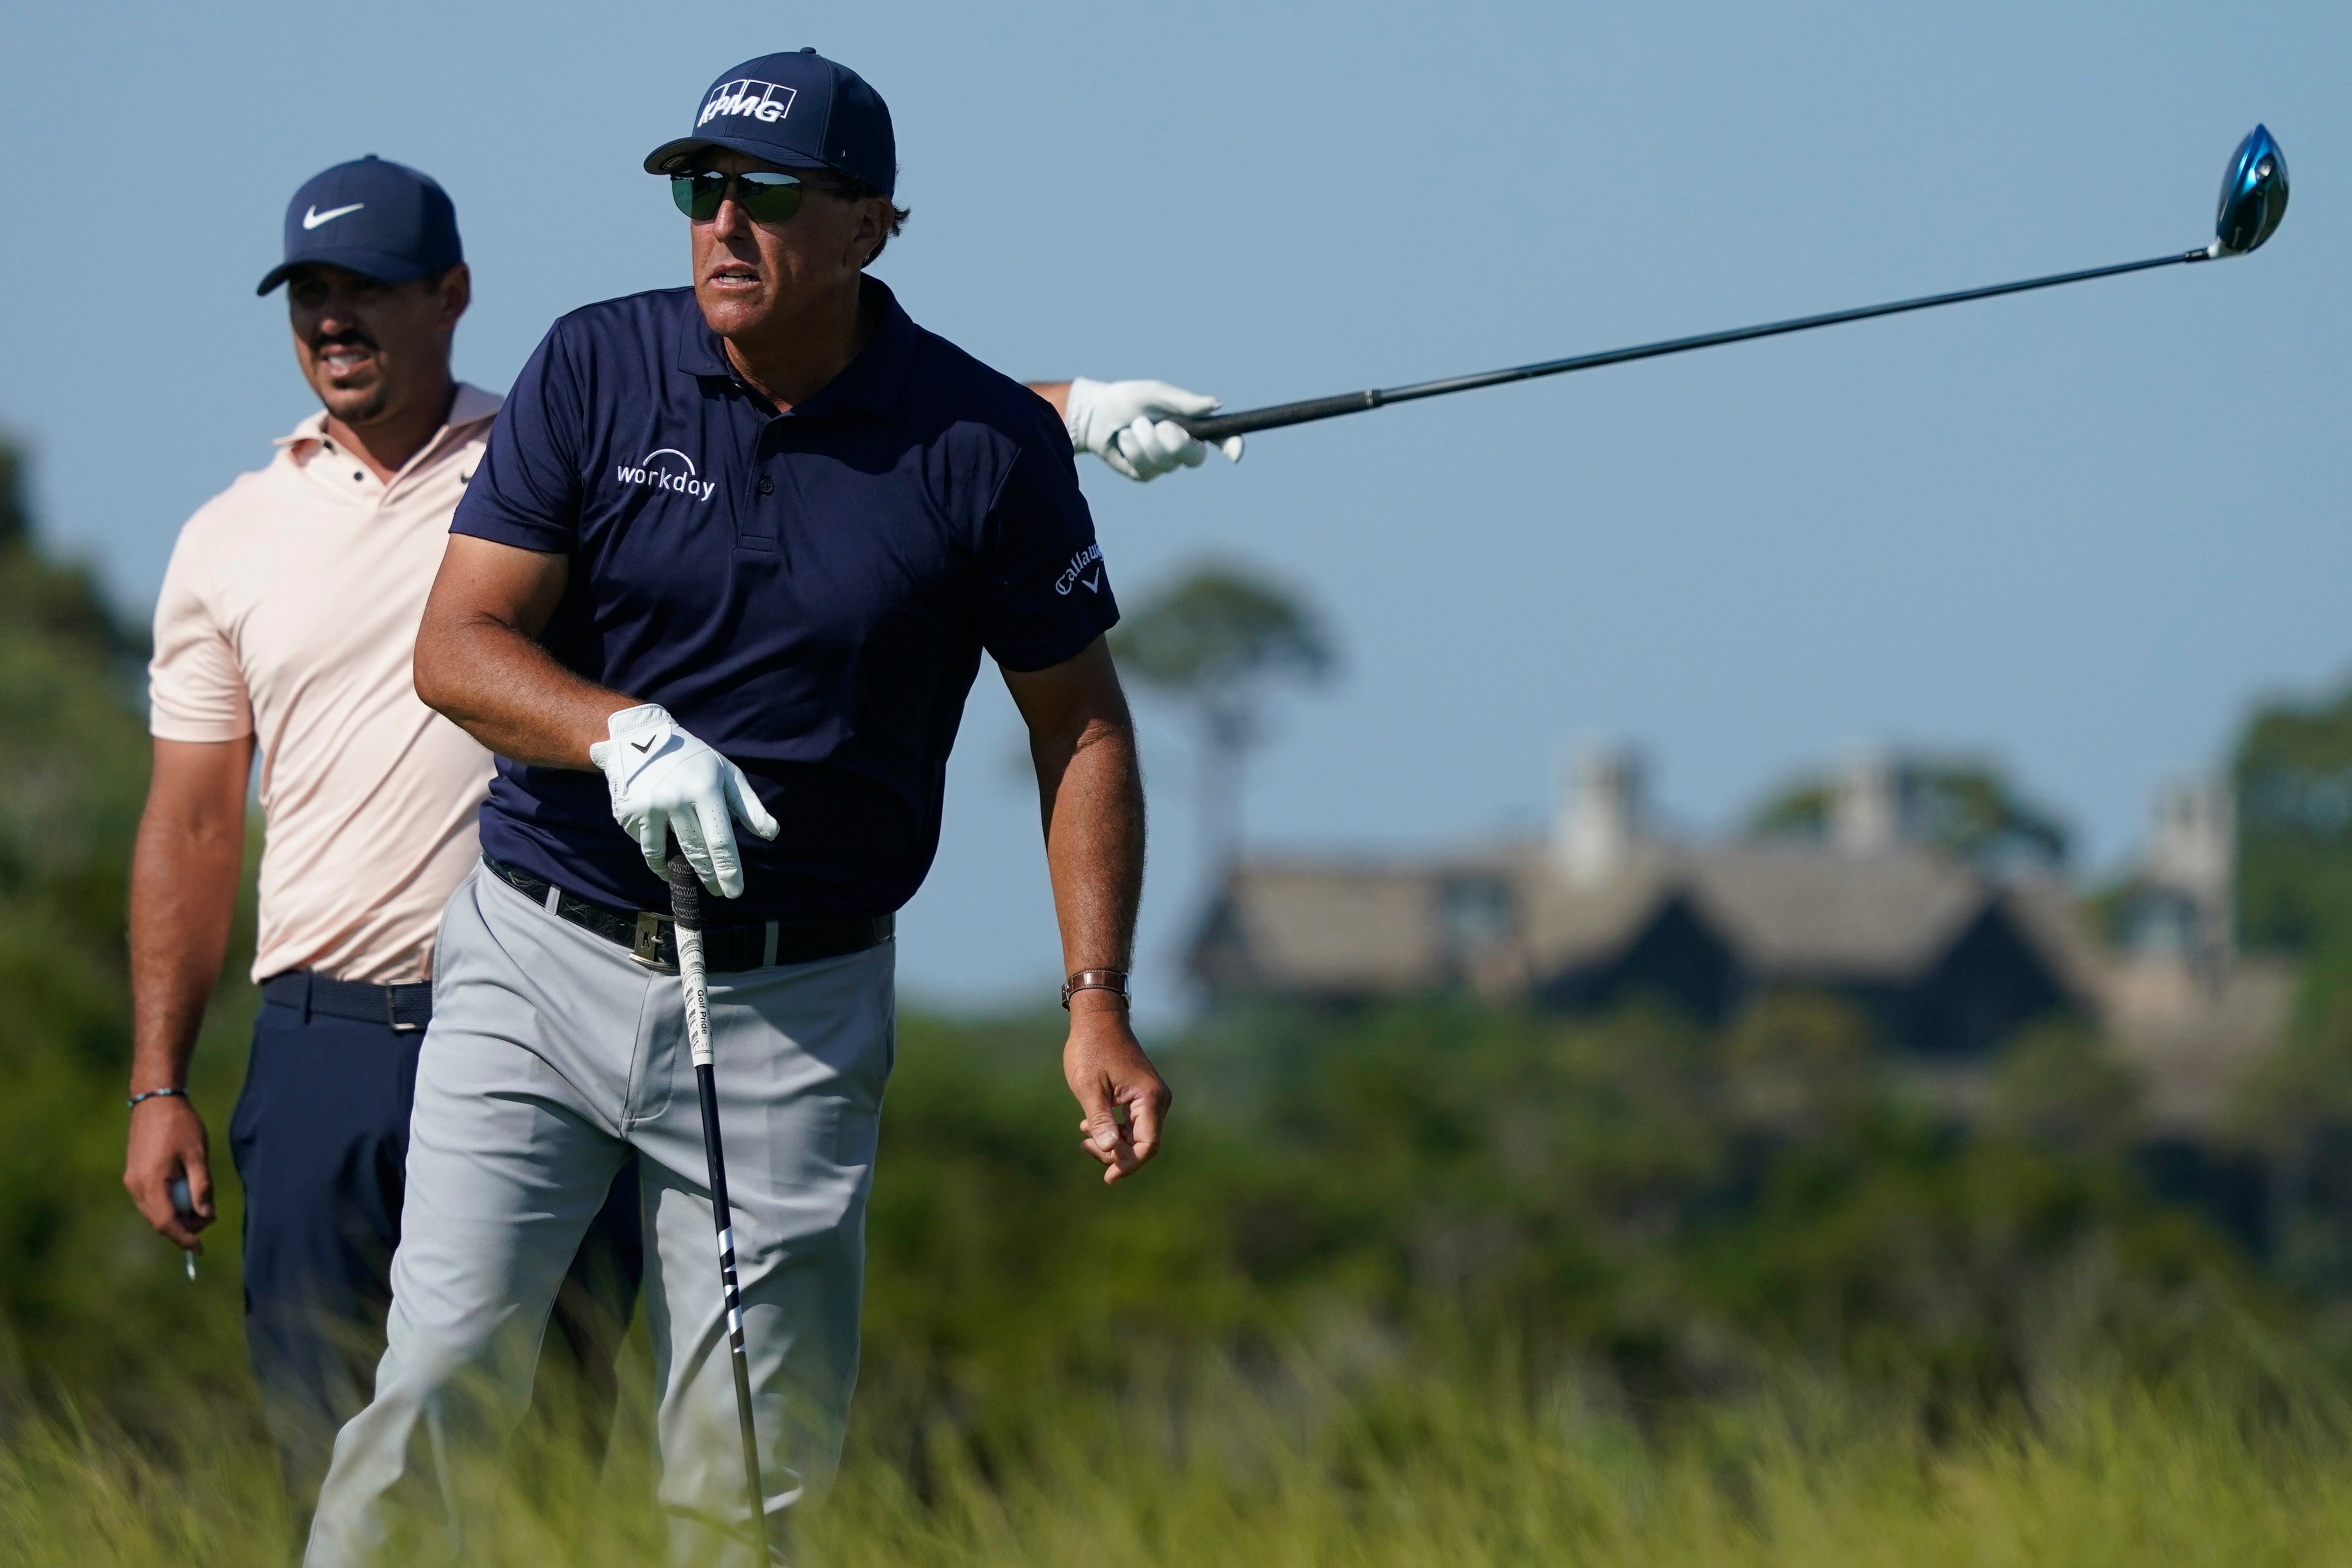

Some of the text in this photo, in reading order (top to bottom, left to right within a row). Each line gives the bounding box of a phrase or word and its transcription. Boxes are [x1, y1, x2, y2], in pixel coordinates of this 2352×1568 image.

[697, 95, 784, 128] KPMG
[618, 465, 715, 501] workday
[697, 990, 706, 1008] Golf
